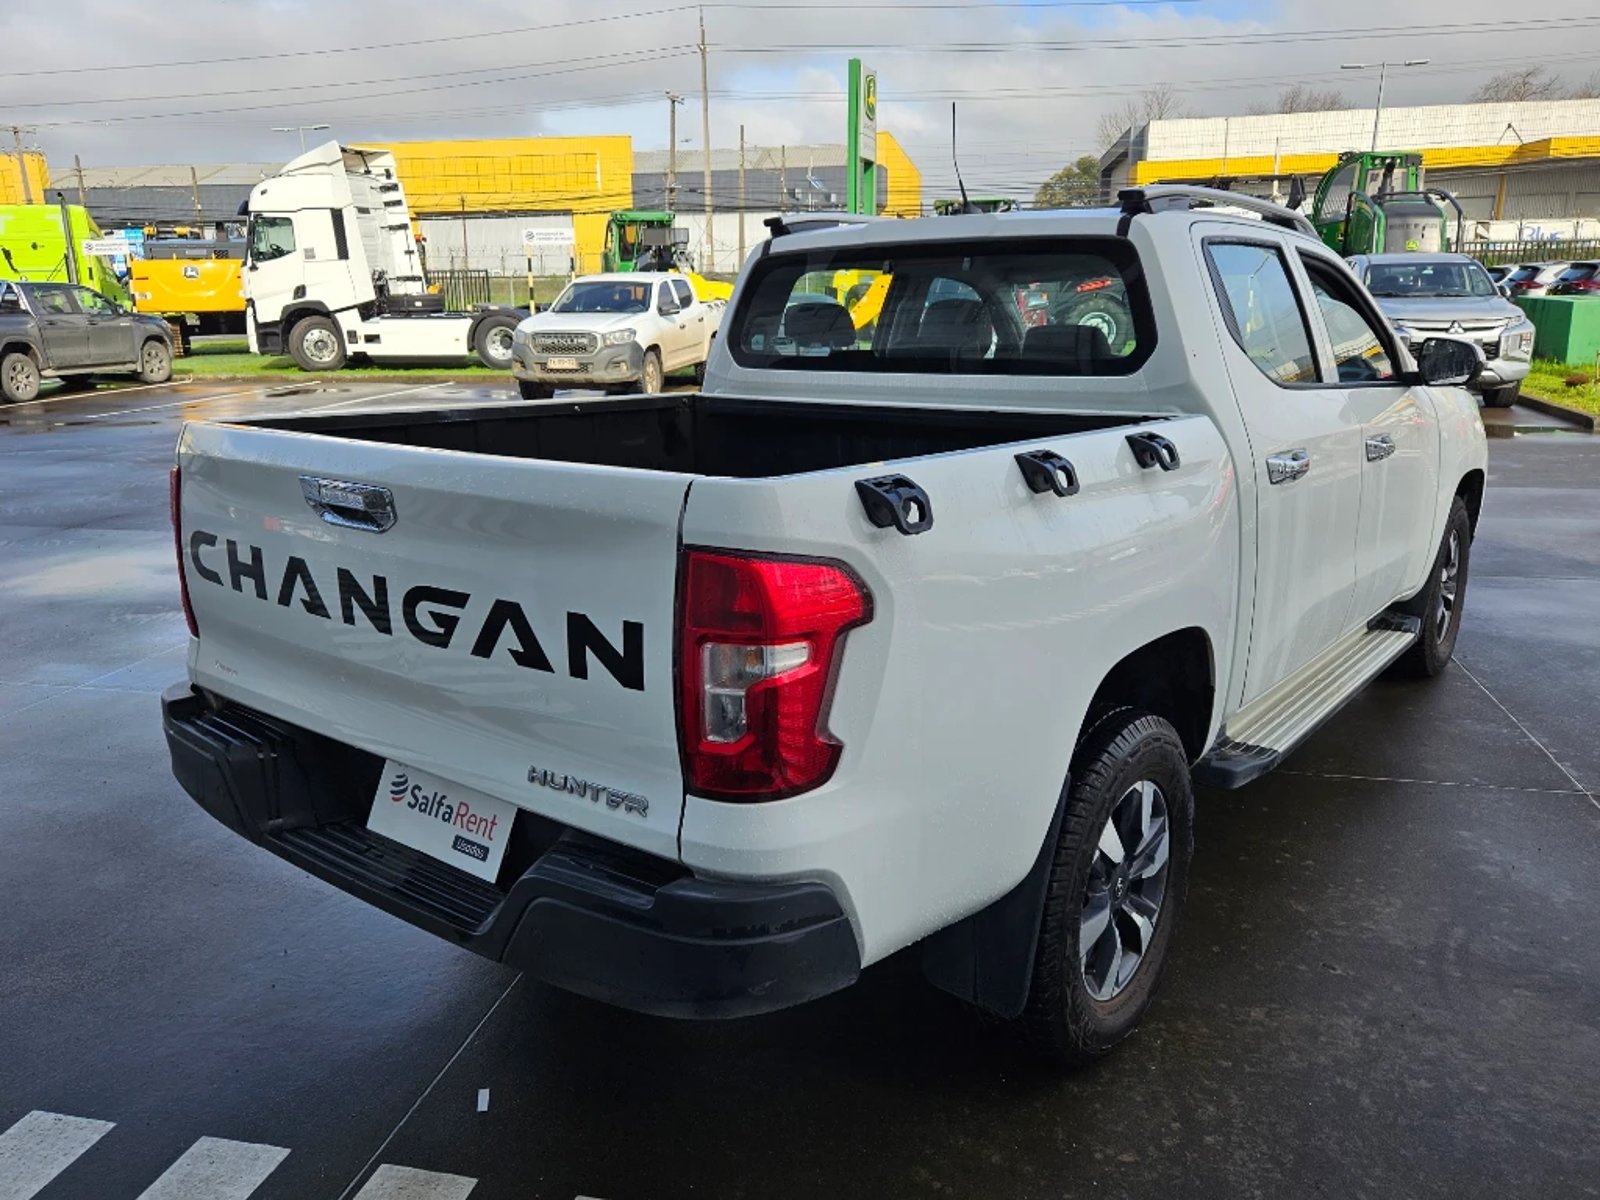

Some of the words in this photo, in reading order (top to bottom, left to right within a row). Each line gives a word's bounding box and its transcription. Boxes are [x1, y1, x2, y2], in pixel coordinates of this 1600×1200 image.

[190, 529, 645, 692] CHANGAN
[408, 783, 498, 841] SalfaRent
[527, 765, 649, 817] HUNTER
